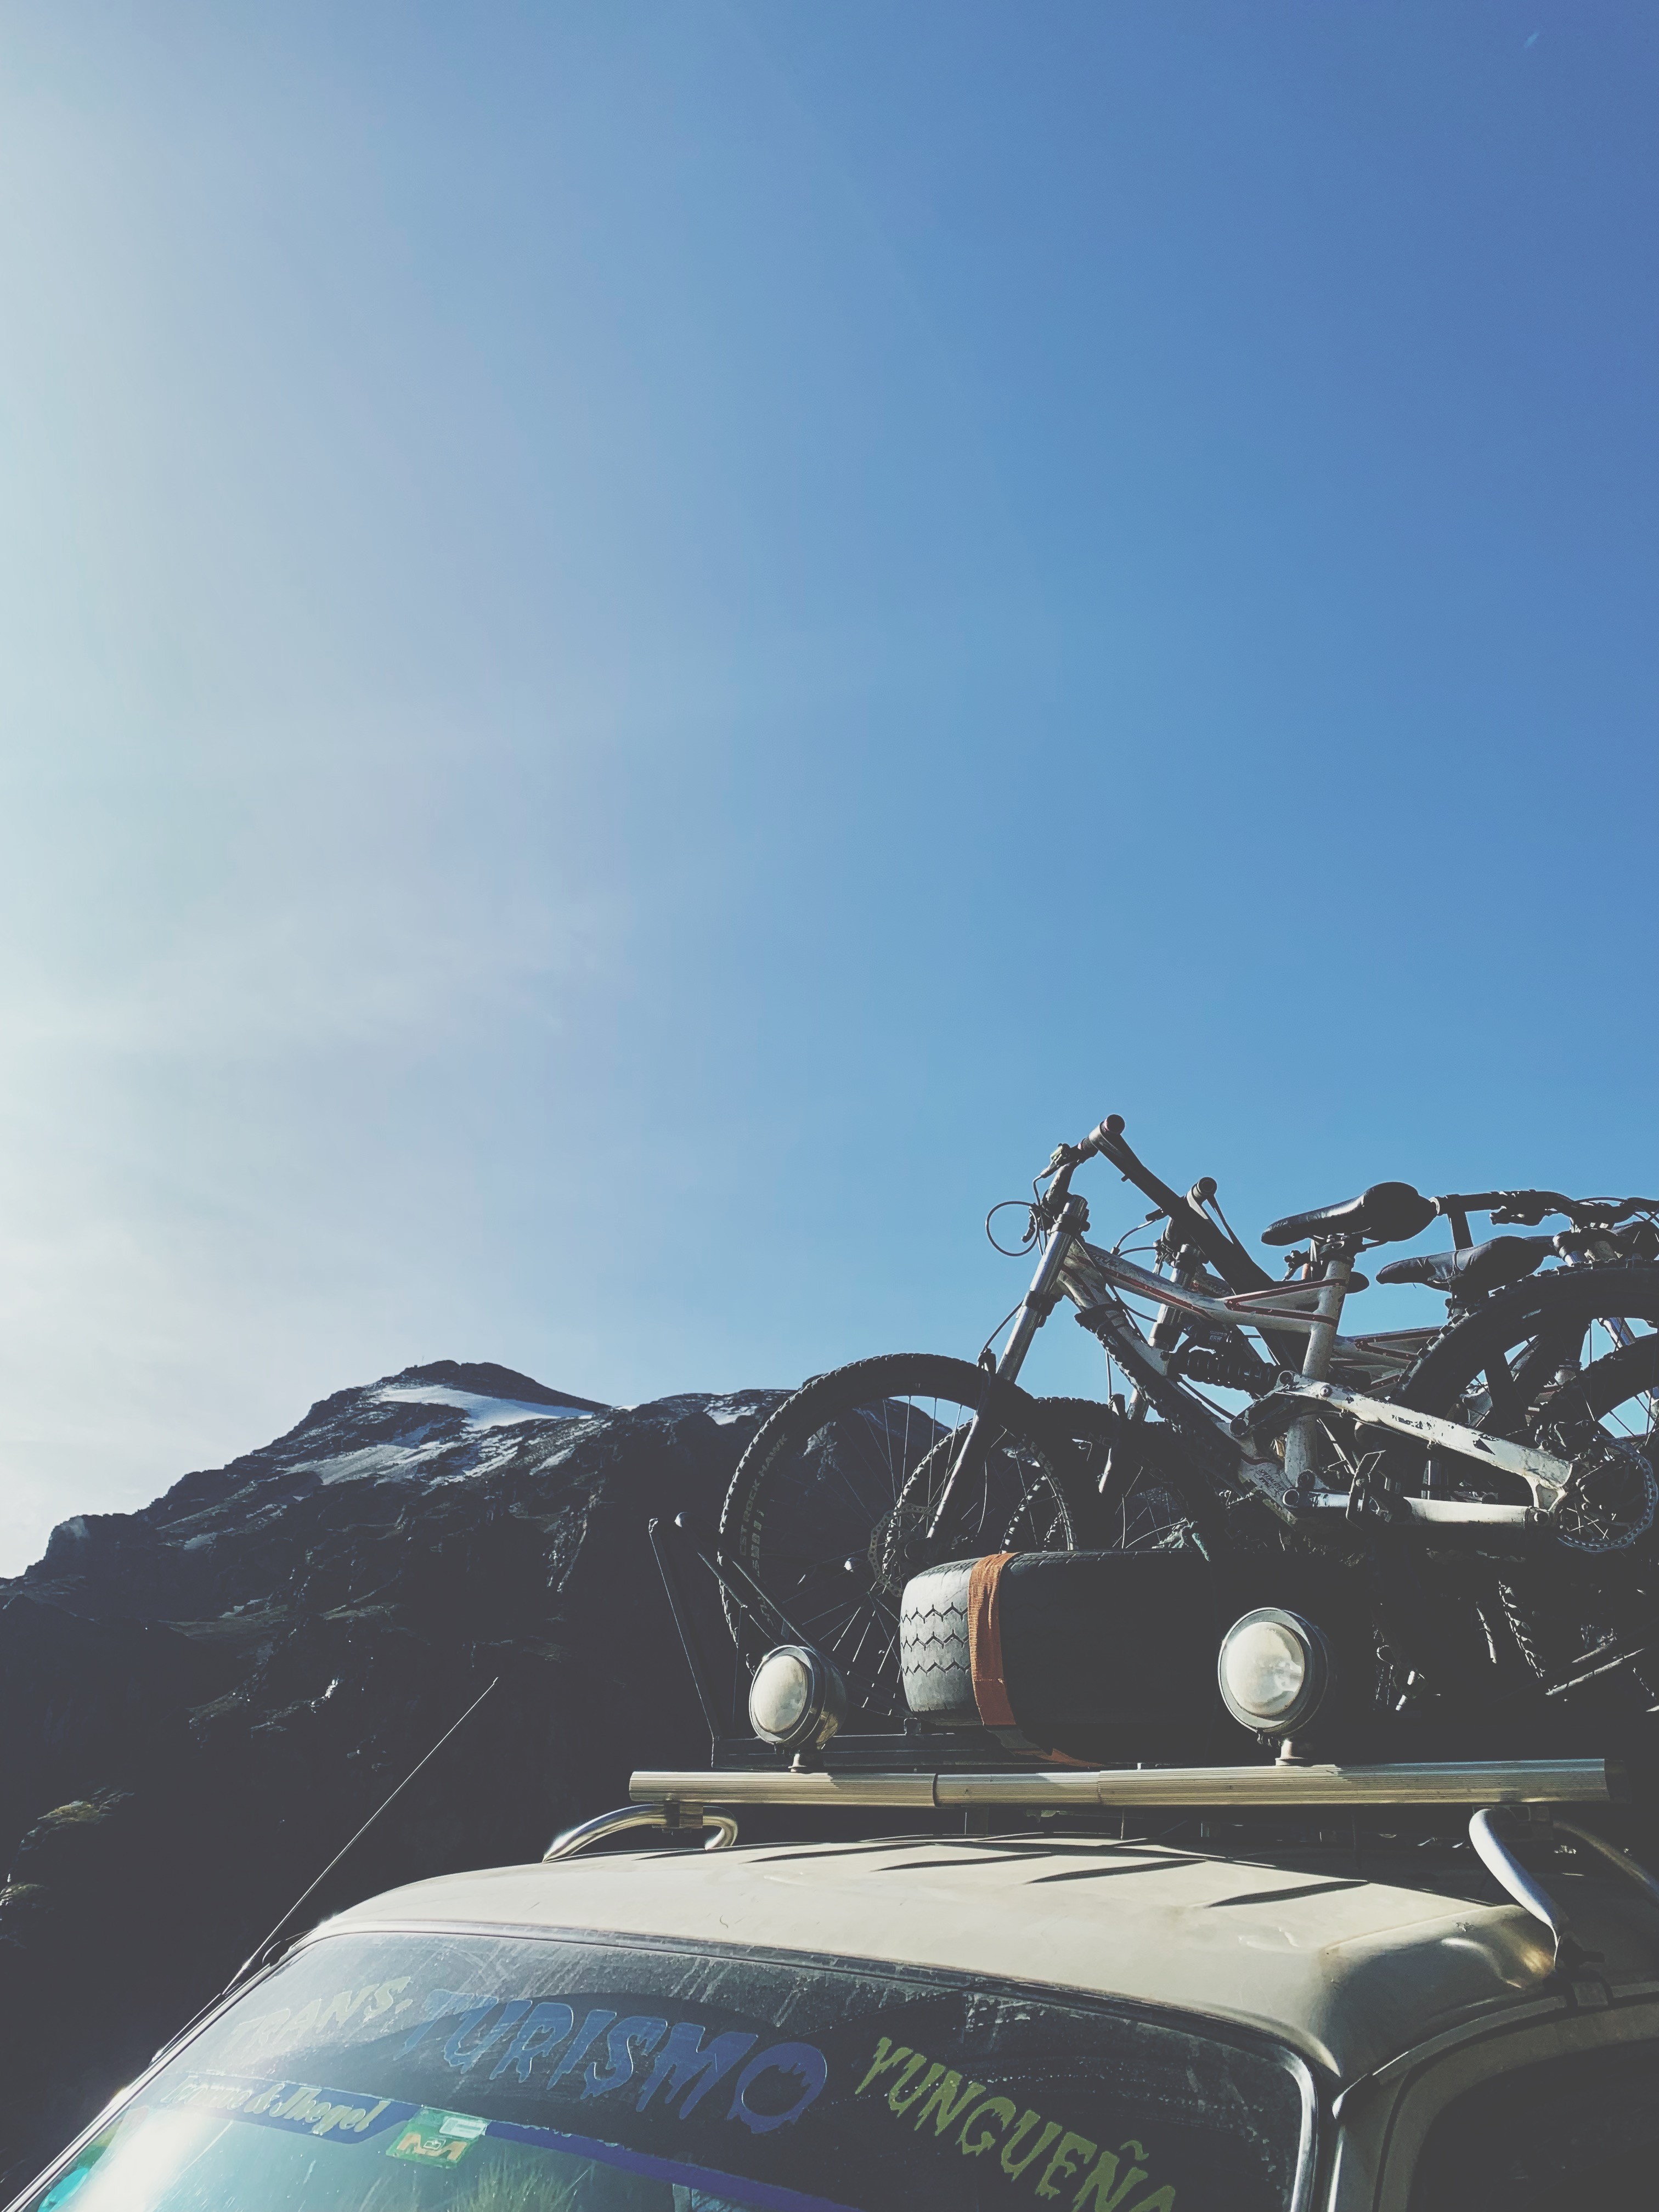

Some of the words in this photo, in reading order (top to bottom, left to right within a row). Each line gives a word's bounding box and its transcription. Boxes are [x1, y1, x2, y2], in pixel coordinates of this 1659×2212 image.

[743, 1479, 760, 1522] ROCK
[758, 1433, 788, 1477] HAWK
[221, 1977, 413, 2057] TRANS.
[393, 1989, 827, 2134] TURISMO
